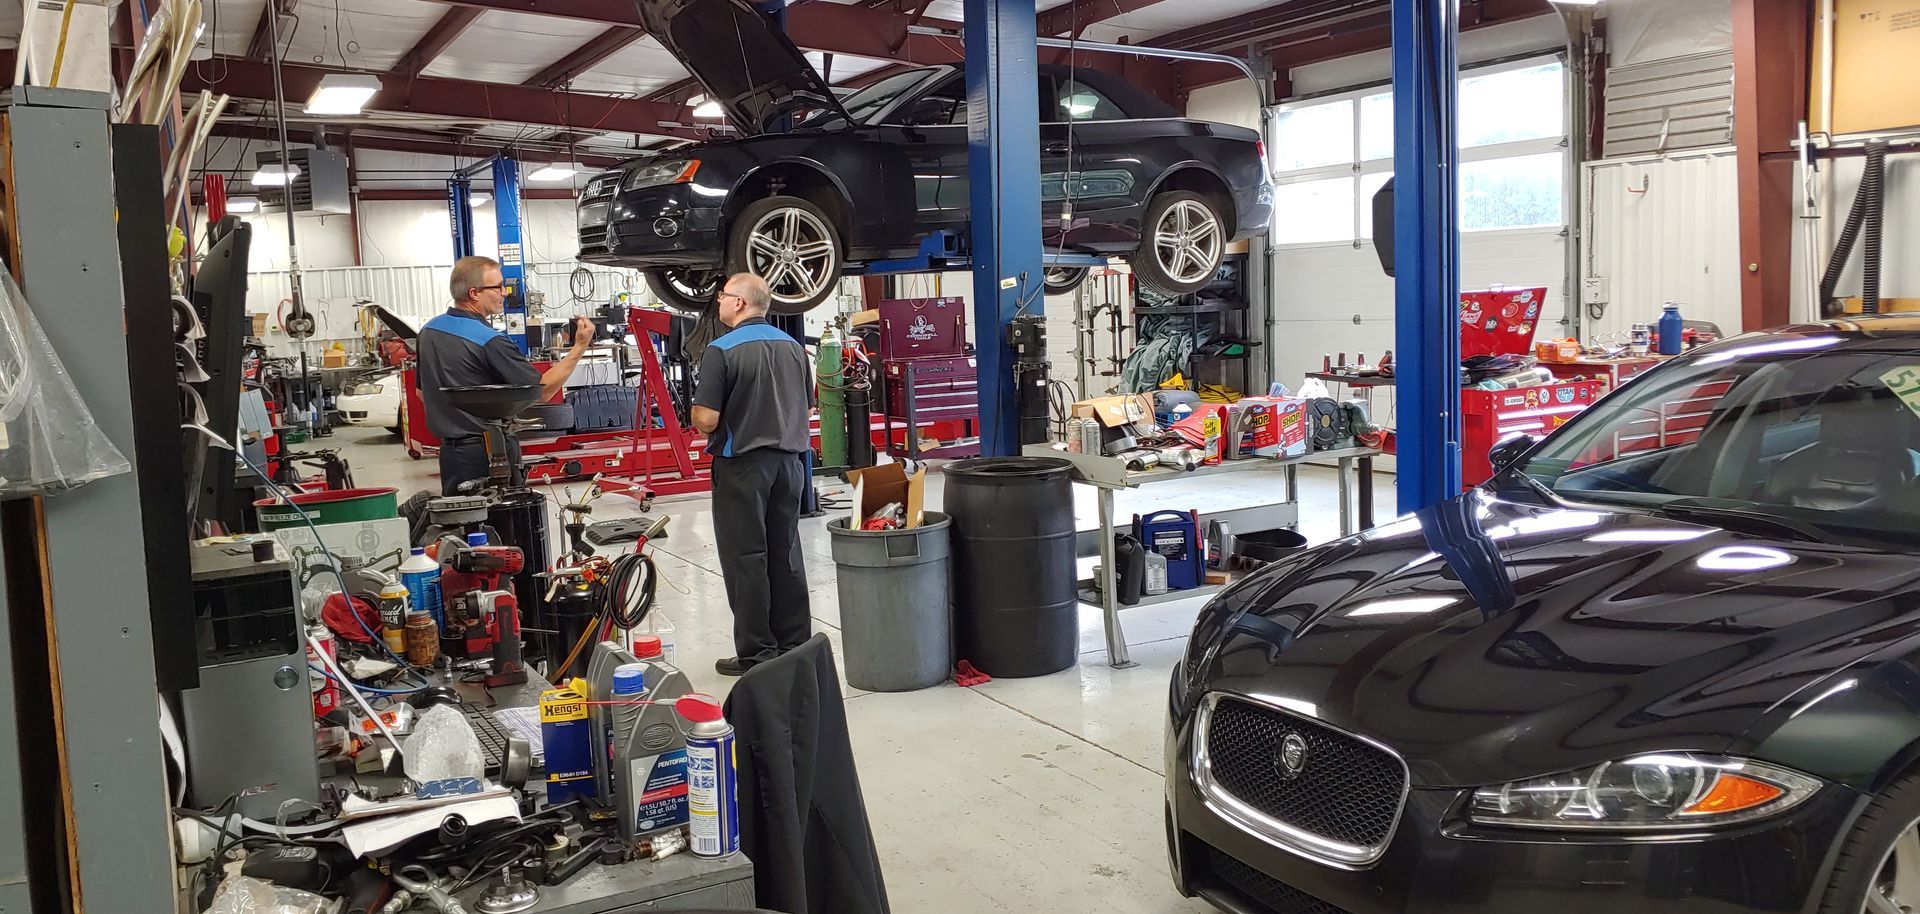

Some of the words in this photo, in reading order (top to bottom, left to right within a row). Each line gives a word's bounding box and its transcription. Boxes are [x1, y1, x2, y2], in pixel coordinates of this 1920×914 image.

[449, 199, 457, 230] ROTARY
[1251, 415, 1269, 427] HOP
[1282, 412, 1301, 428] SHOP
[657, 756, 688, 769] PENTOFRO
